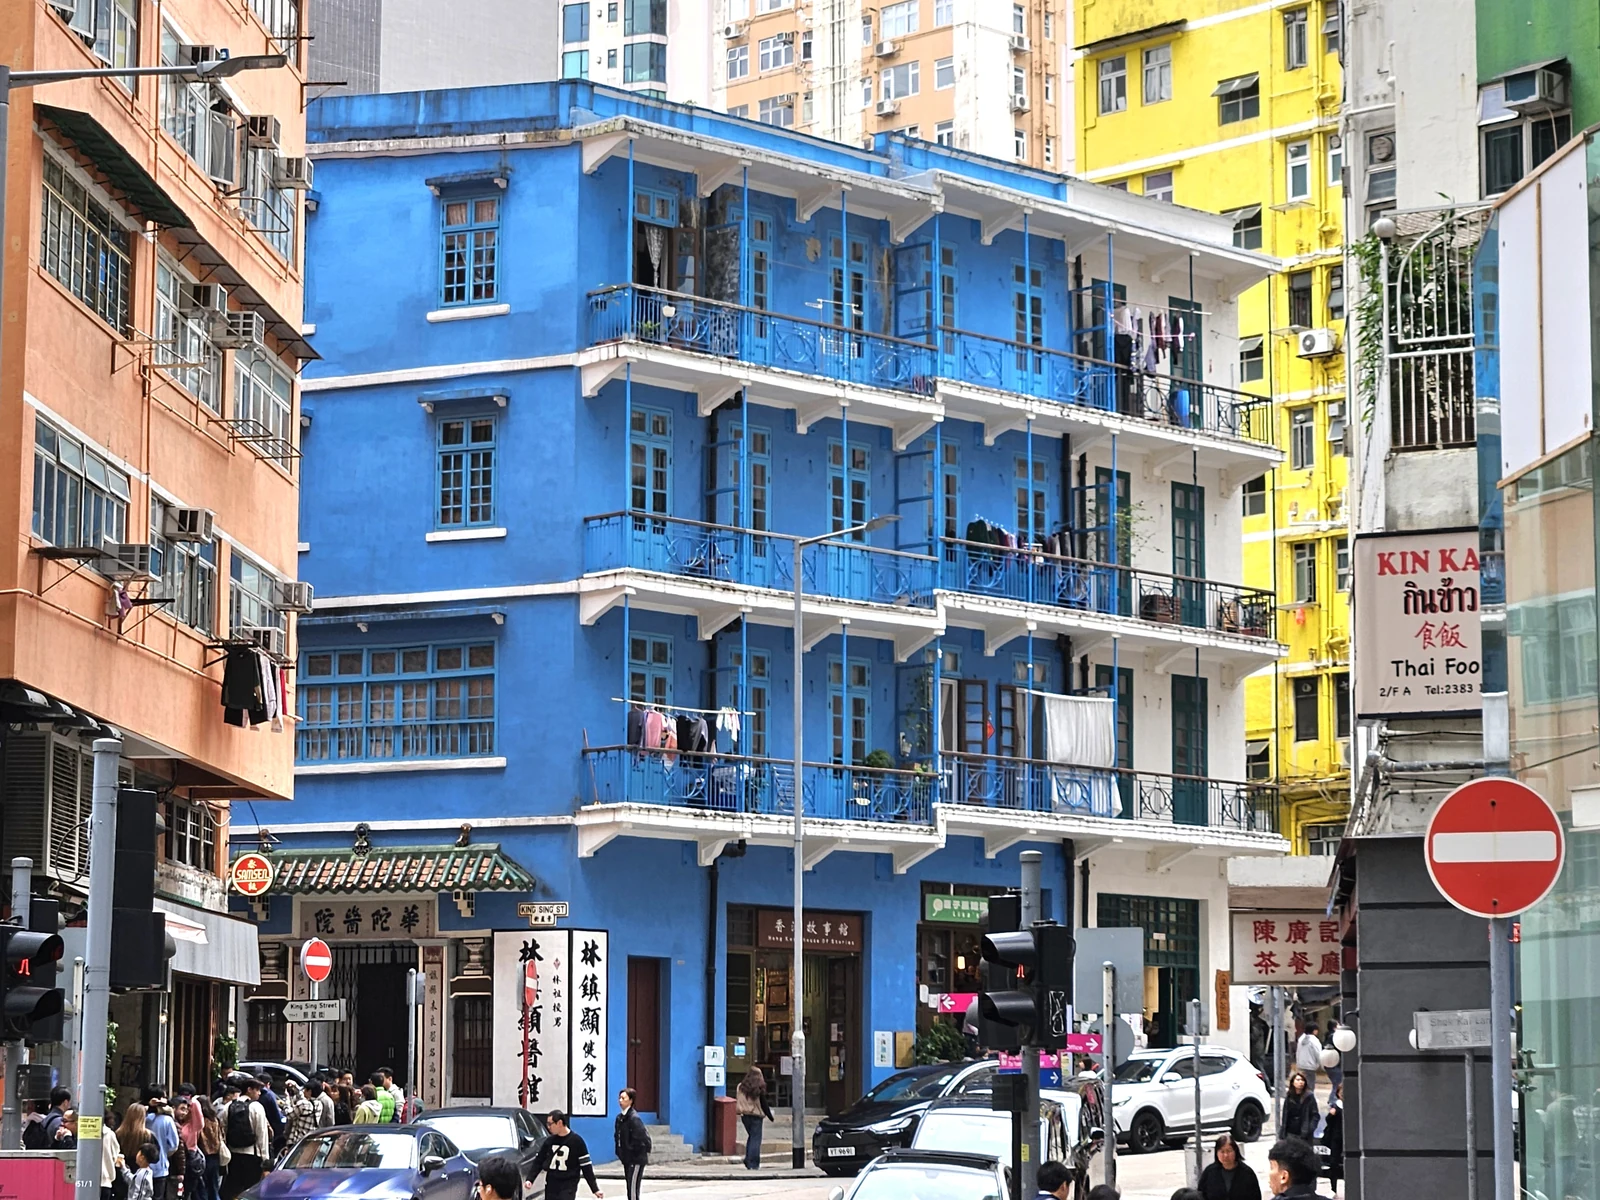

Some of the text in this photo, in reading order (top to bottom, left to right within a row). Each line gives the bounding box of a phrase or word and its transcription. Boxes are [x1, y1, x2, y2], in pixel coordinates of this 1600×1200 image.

[1377, 548, 1480, 576] KIN KA
[1414, 620, 1468, 650] 食飯
[1391, 658, 1480, 677] Thai Foo
[1379, 686, 1399, 698] 2/F
[1403, 686, 1411, 696] A
[1424, 683, 1474, 695] Tel:2383
[236, 869, 269, 880] SAMSEN
[521, 905, 565, 914] KING SING ST
[1253, 919, 1340, 944] 陳廣記
[517, 938, 544, 1105] 林顯醫館
[578, 939, 602, 1107] 林鎮顯健身院
[549, 1144, 570, 1171] R
